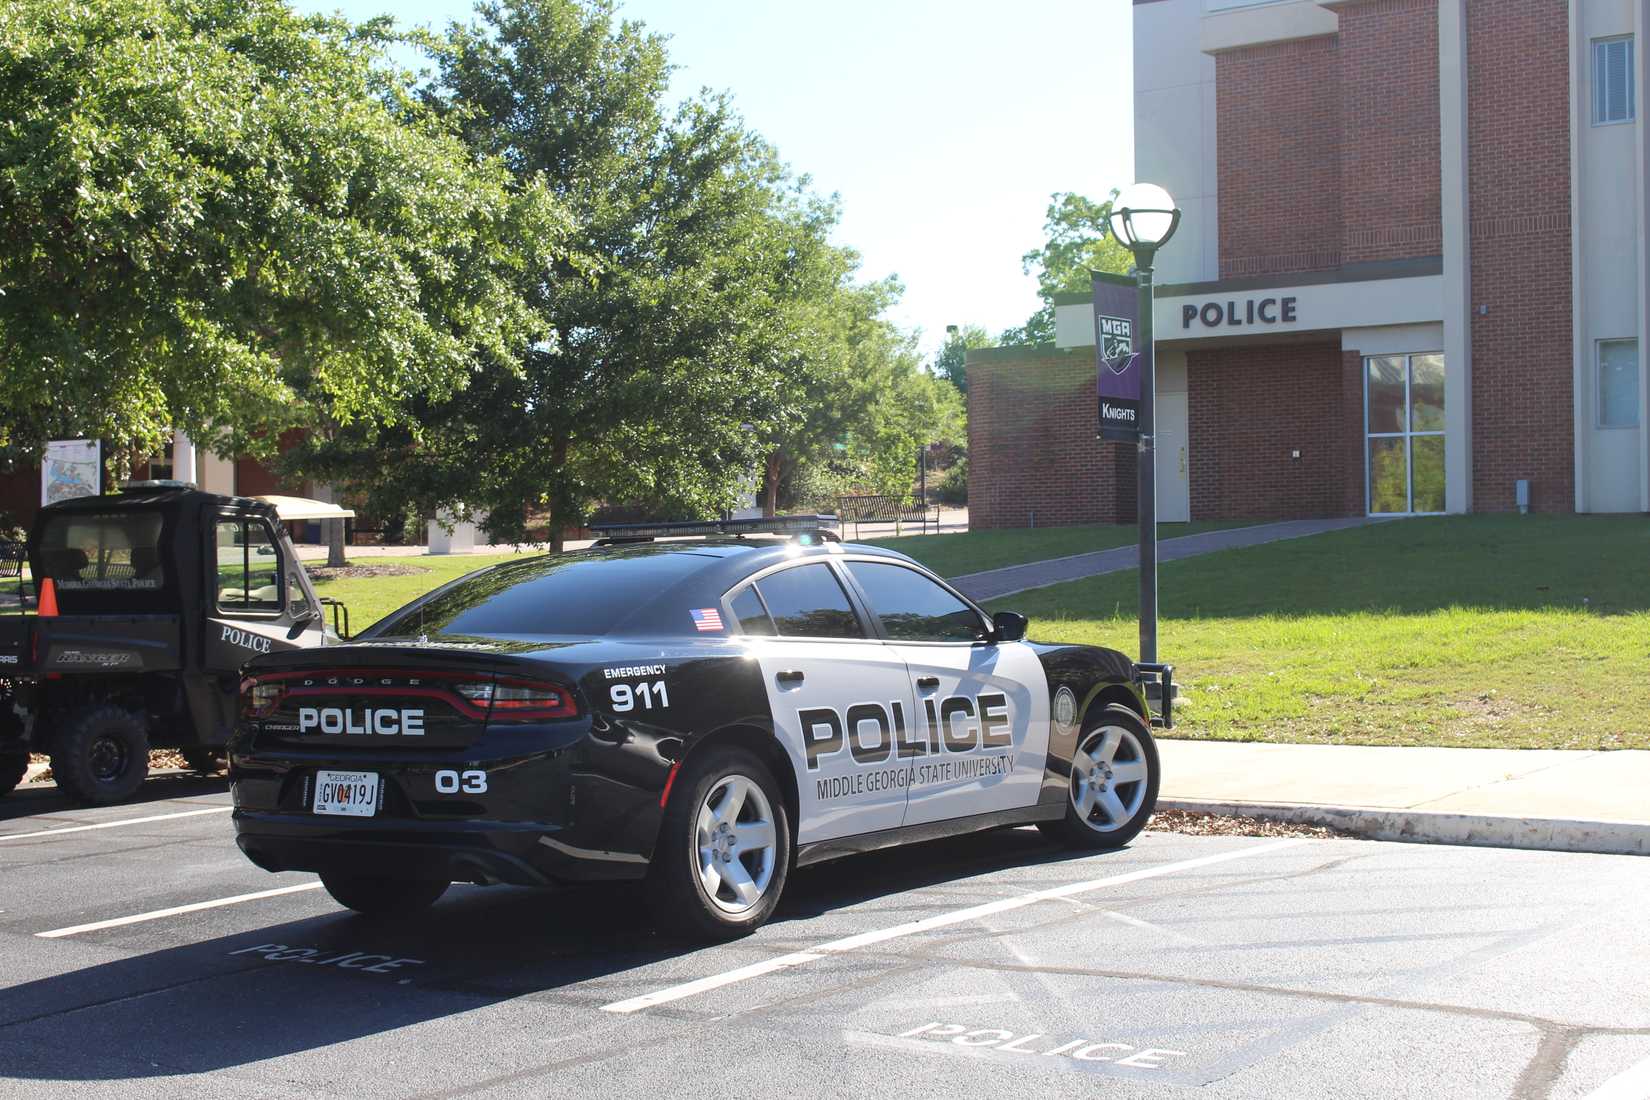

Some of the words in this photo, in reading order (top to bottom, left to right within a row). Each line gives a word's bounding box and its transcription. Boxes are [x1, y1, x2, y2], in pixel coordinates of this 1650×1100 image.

[1182, 296, 1297, 329] POLICE
[1101, 318, 1130, 337] MGA
[221, 625, 272, 653] POLICE
[304, 678, 420, 686] DODGE
[604, 664, 667, 679] EMERGENCY
[610, 680, 669, 712] 911
[299, 707, 425, 736] POLICE
[797, 691, 1013, 773] POLICE
[329, 774, 364, 782] GEORGIA
[434, 769, 488, 794] 03
[816, 774, 863, 801] MIDDLE
[865, 768, 916, 792] GEORGIA
[918, 762, 952, 784] STATE
[953, 754, 1015, 780] UNIVERSITY
[228, 943, 425, 973] POLICE
[899, 1021, 1187, 1069] POLICE
